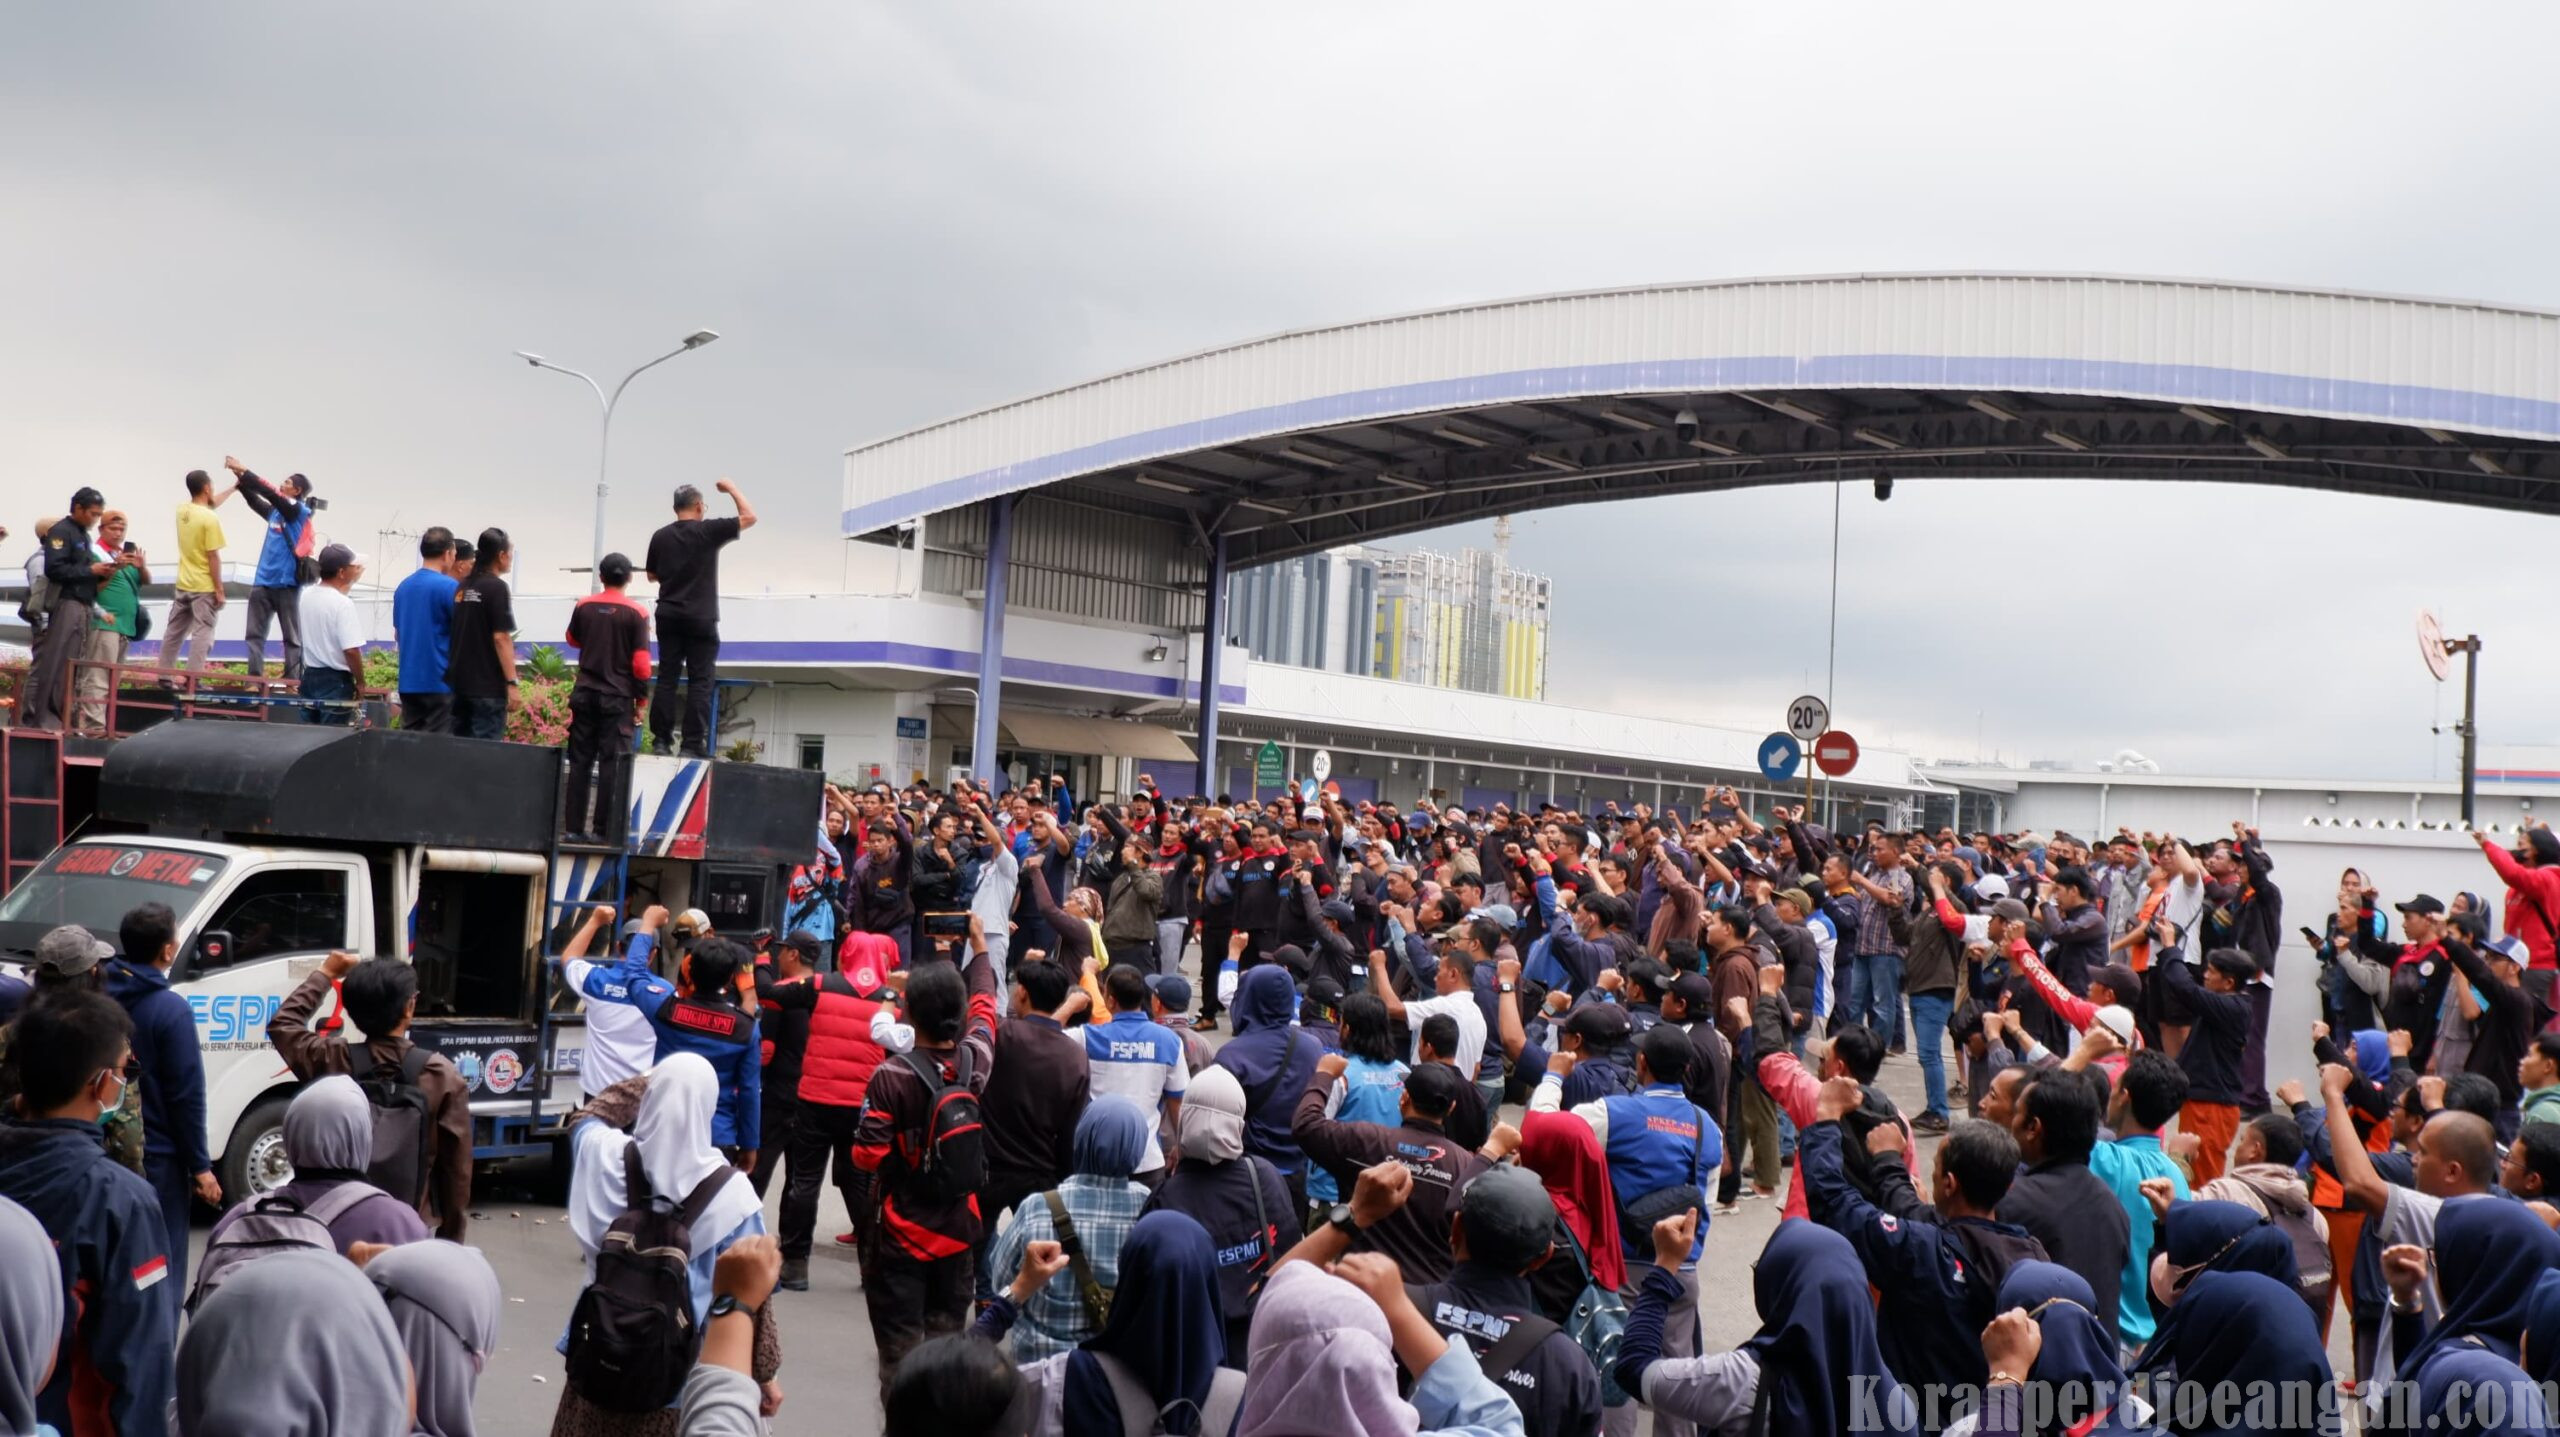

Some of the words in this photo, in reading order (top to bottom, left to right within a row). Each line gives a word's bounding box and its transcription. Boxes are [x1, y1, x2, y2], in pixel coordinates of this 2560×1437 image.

[1793, 706, 1813, 729] 20
[55, 848, 122, 875] GARDA
[128, 850, 205, 886] METAL
[676, 1006, 712, 1028] BRIGADE
[712, 1015, 733, 1032] SPSI
[210, 1042, 234, 1051] SERIKAT
[234, 1041, 259, 1051] PEKERJA
[440, 1038, 454, 1046] SPA
[455, 1037, 477, 1045] FSPMI
[514, 1035, 538, 1044] BEKASI
[1110, 1041, 1155, 1059] FSPMI
[1398, 1142, 1431, 1158] FSPMI
[1218, 1240, 1260, 1265] FSPMI
[1436, 1301, 1510, 1338] FSPMI
